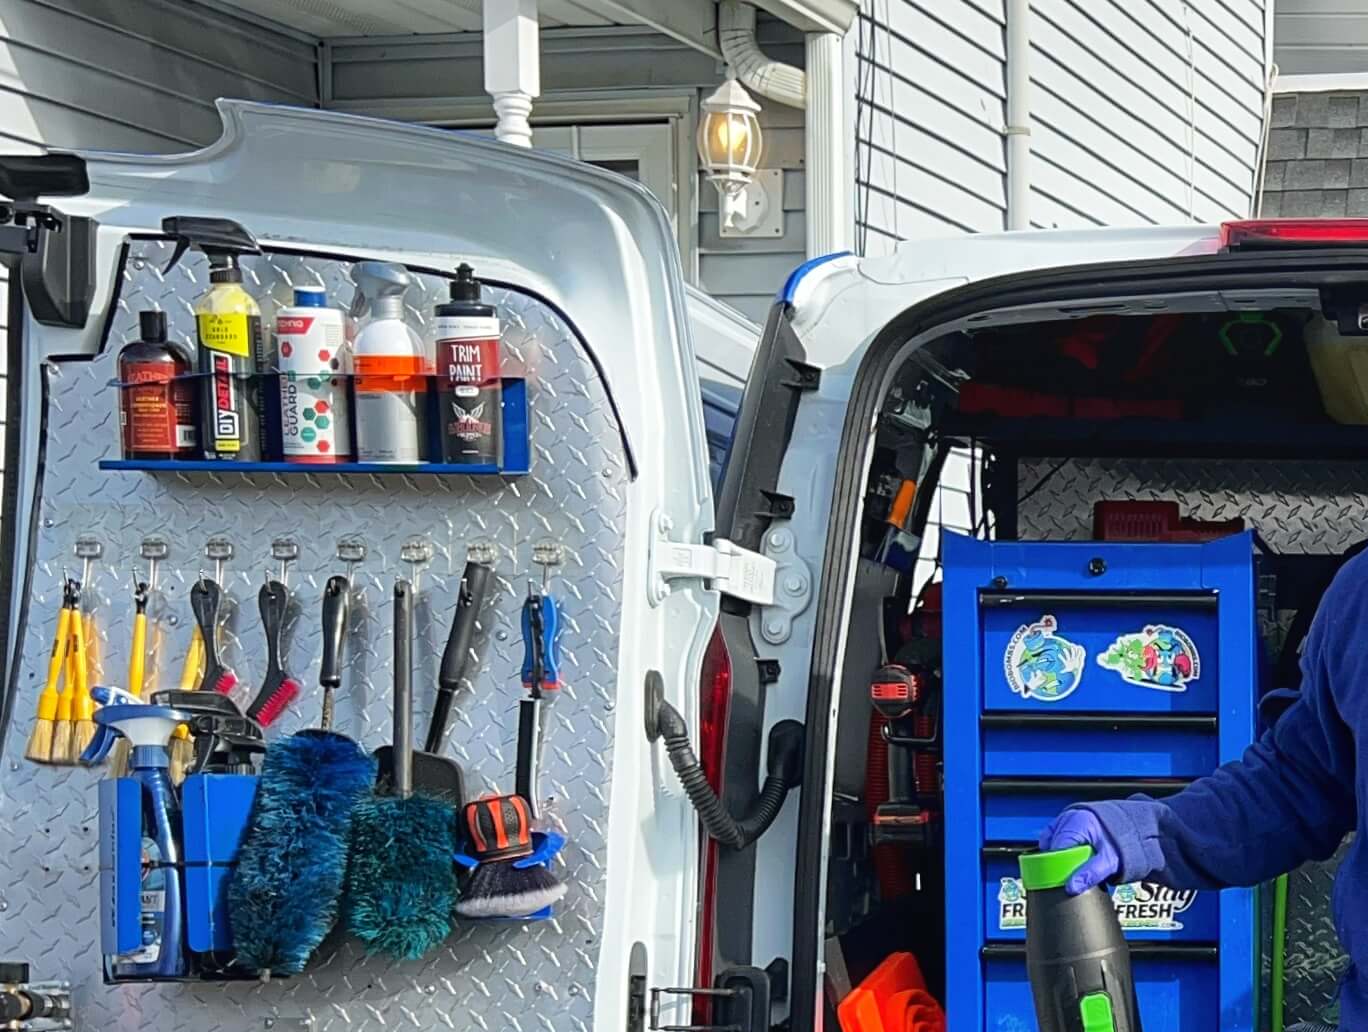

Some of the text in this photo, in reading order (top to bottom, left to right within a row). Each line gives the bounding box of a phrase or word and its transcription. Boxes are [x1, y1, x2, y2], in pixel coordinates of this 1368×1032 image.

[451, 345, 481, 362] TRIM
[449, 364, 482, 382] PAINT
[288, 384, 299, 436] GUARD
[219, 410, 234, 434] DIY
[1134, 881, 1198, 911] Stay
[1117, 903, 1173, 919] FRESH
